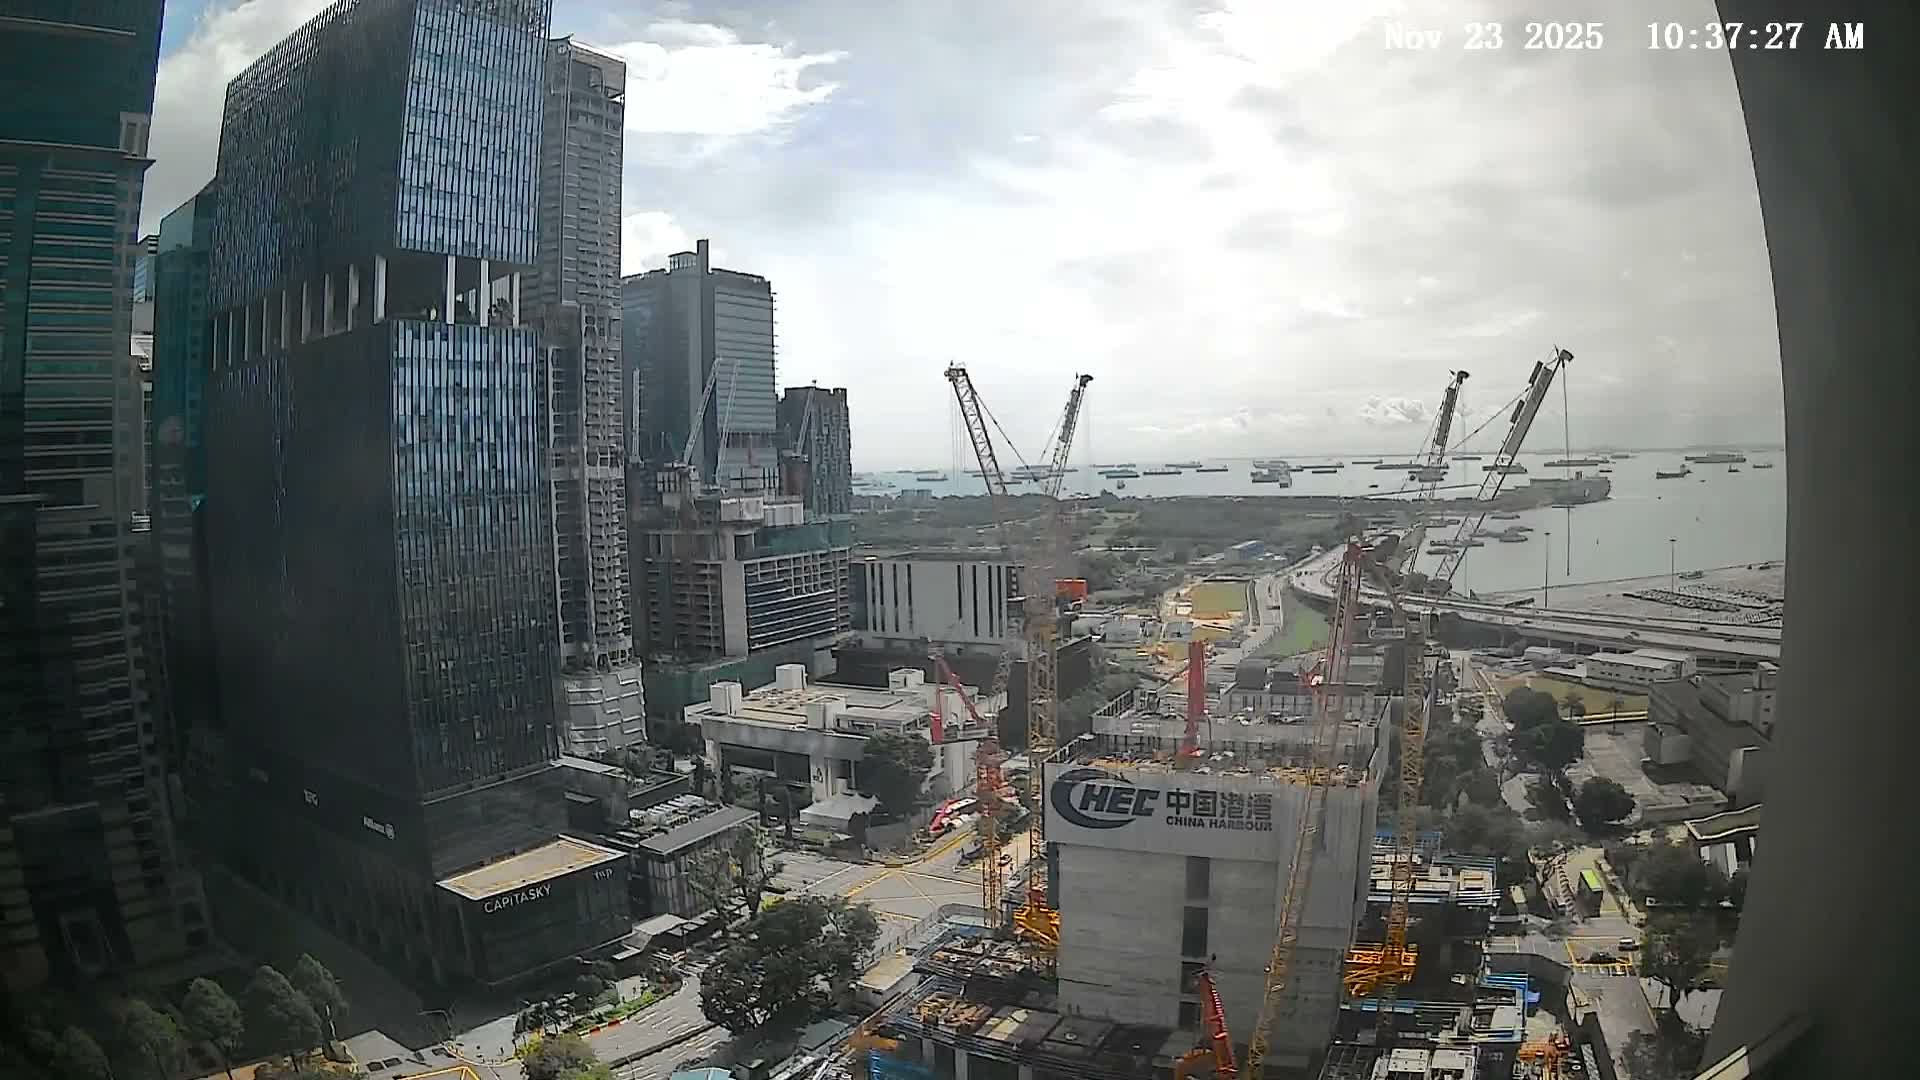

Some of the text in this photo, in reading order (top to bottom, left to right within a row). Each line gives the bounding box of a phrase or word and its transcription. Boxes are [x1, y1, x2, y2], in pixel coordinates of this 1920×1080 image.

[1166, 788, 1273, 820] 中国港湾
[1166, 816, 1273, 832] CHINA HARBOUR
[484, 884, 551, 914] CAPITASKY
